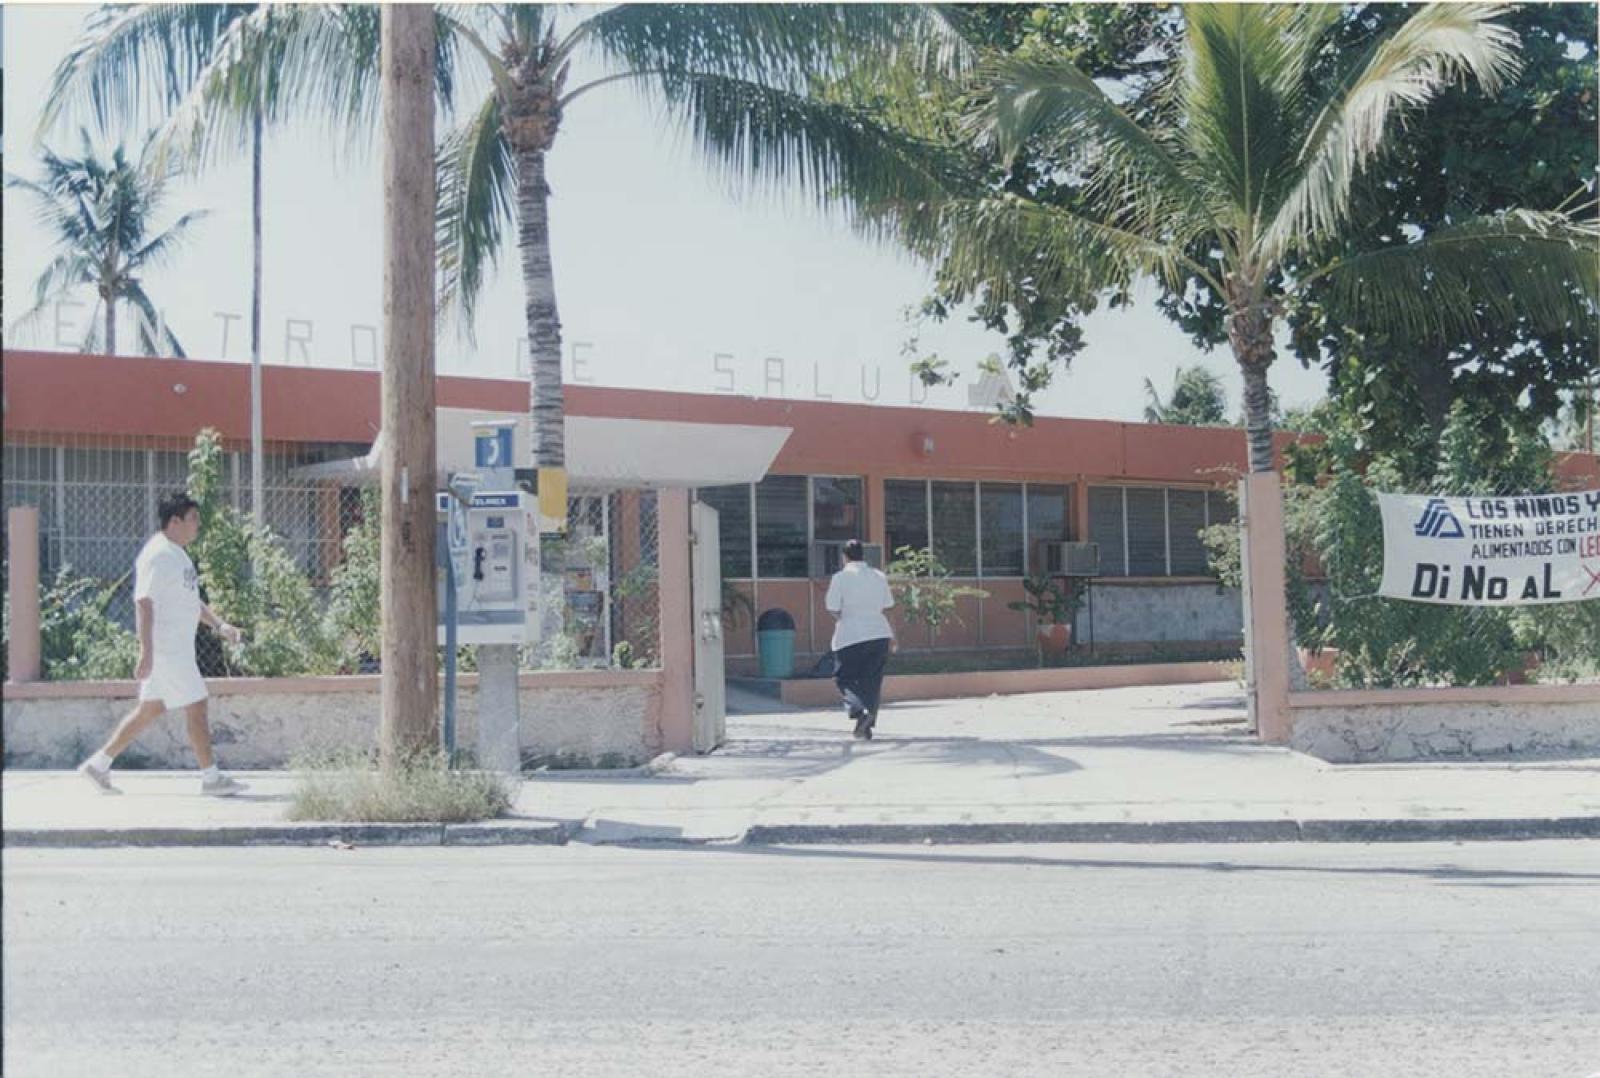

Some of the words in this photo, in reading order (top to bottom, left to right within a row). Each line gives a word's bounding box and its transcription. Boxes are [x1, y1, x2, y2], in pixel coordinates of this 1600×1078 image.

[713, 353, 928, 405] SALUD
[1466, 499, 1508, 519] LOS
[1469, 523, 1524, 539] TIENEN
[1471, 539, 1553, 559] ALIMENTADOS
[1557, 538, 1577, 554] CON
